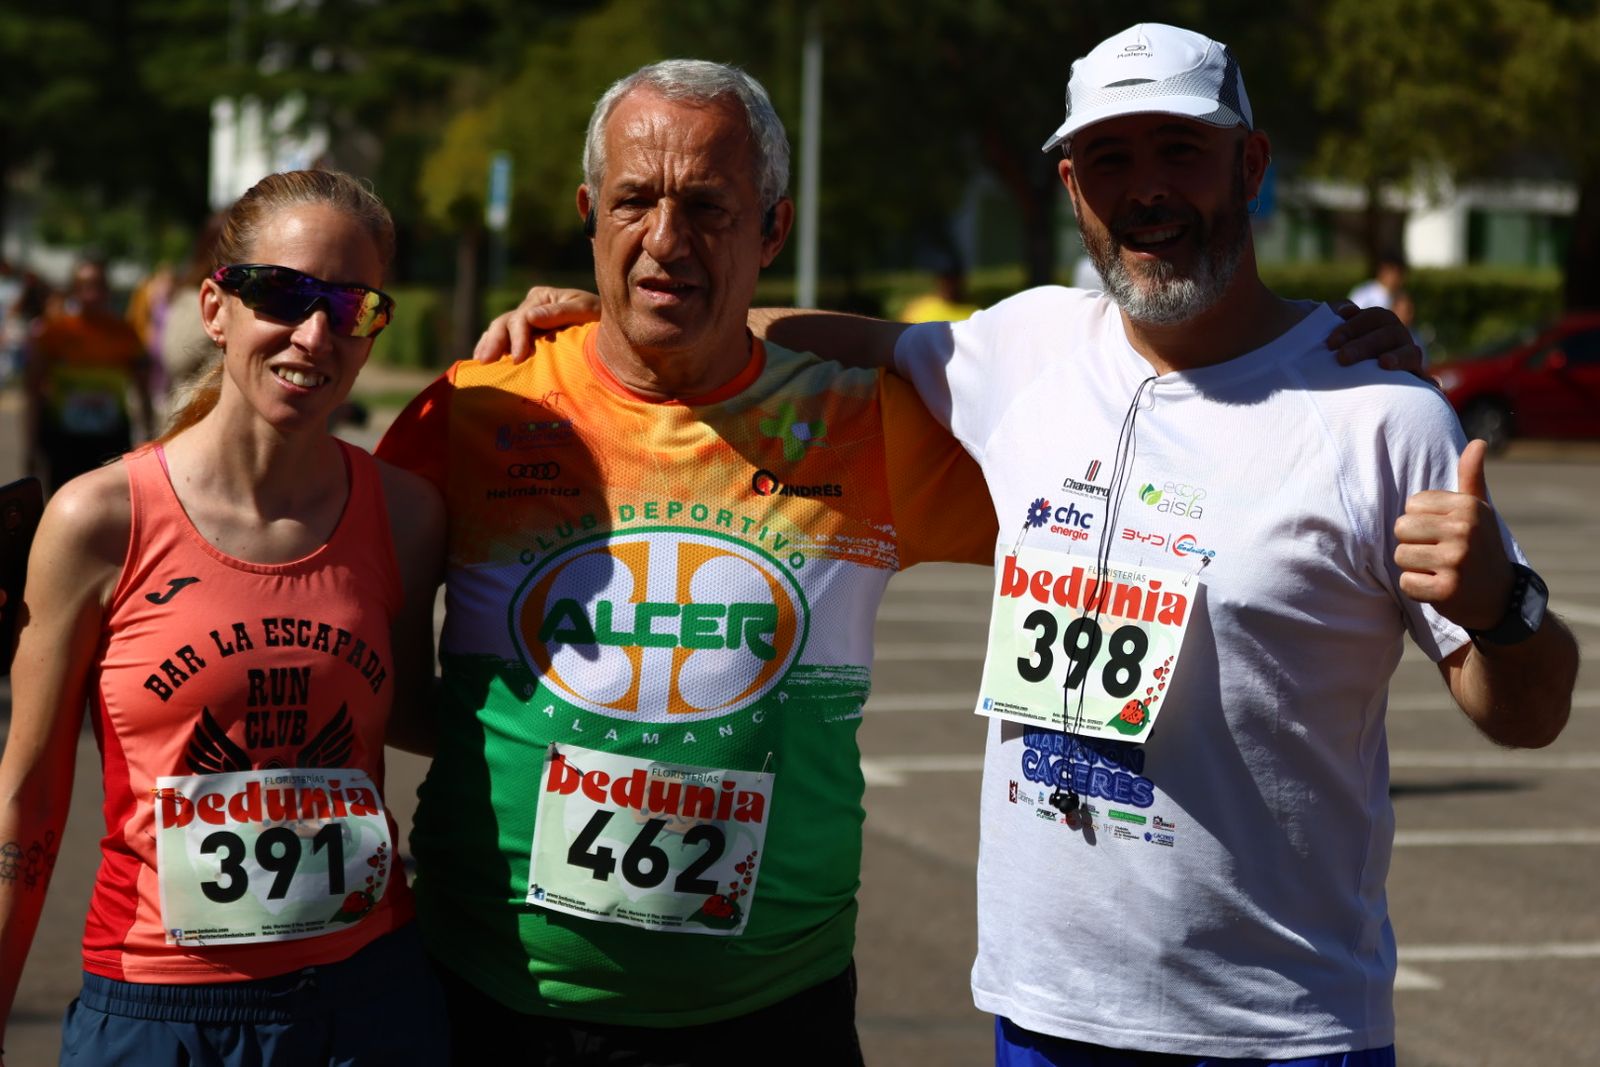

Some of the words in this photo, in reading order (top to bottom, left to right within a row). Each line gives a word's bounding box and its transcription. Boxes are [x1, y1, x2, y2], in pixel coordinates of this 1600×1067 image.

[1054, 503, 1094, 529] chc
[1063, 478, 1110, 497] Chaparro
[520, 514, 597, 566] CLUB
[618, 501, 806, 570] DEPORTIVO
[1122, 528, 1165, 546] BYD
[1000, 555, 1188, 628] bedunia
[143, 644, 208, 702] BAR
[210, 621, 254, 658] LA
[261, 617, 387, 694] ESCAPADA
[539, 597, 777, 661] ALCER
[1017, 609, 1149, 699] 398
[246, 666, 312, 708] RUN
[522, 684, 790, 744] SALAMANCA
[244, 708, 309, 751] CLUB
[161, 779, 379, 830] bedunia
[546, 754, 766, 824] bedunia
[651, 766, 720, 785] FLORISTERÍAS
[200, 823, 346, 904] 391
[566, 809, 726, 896] 462
